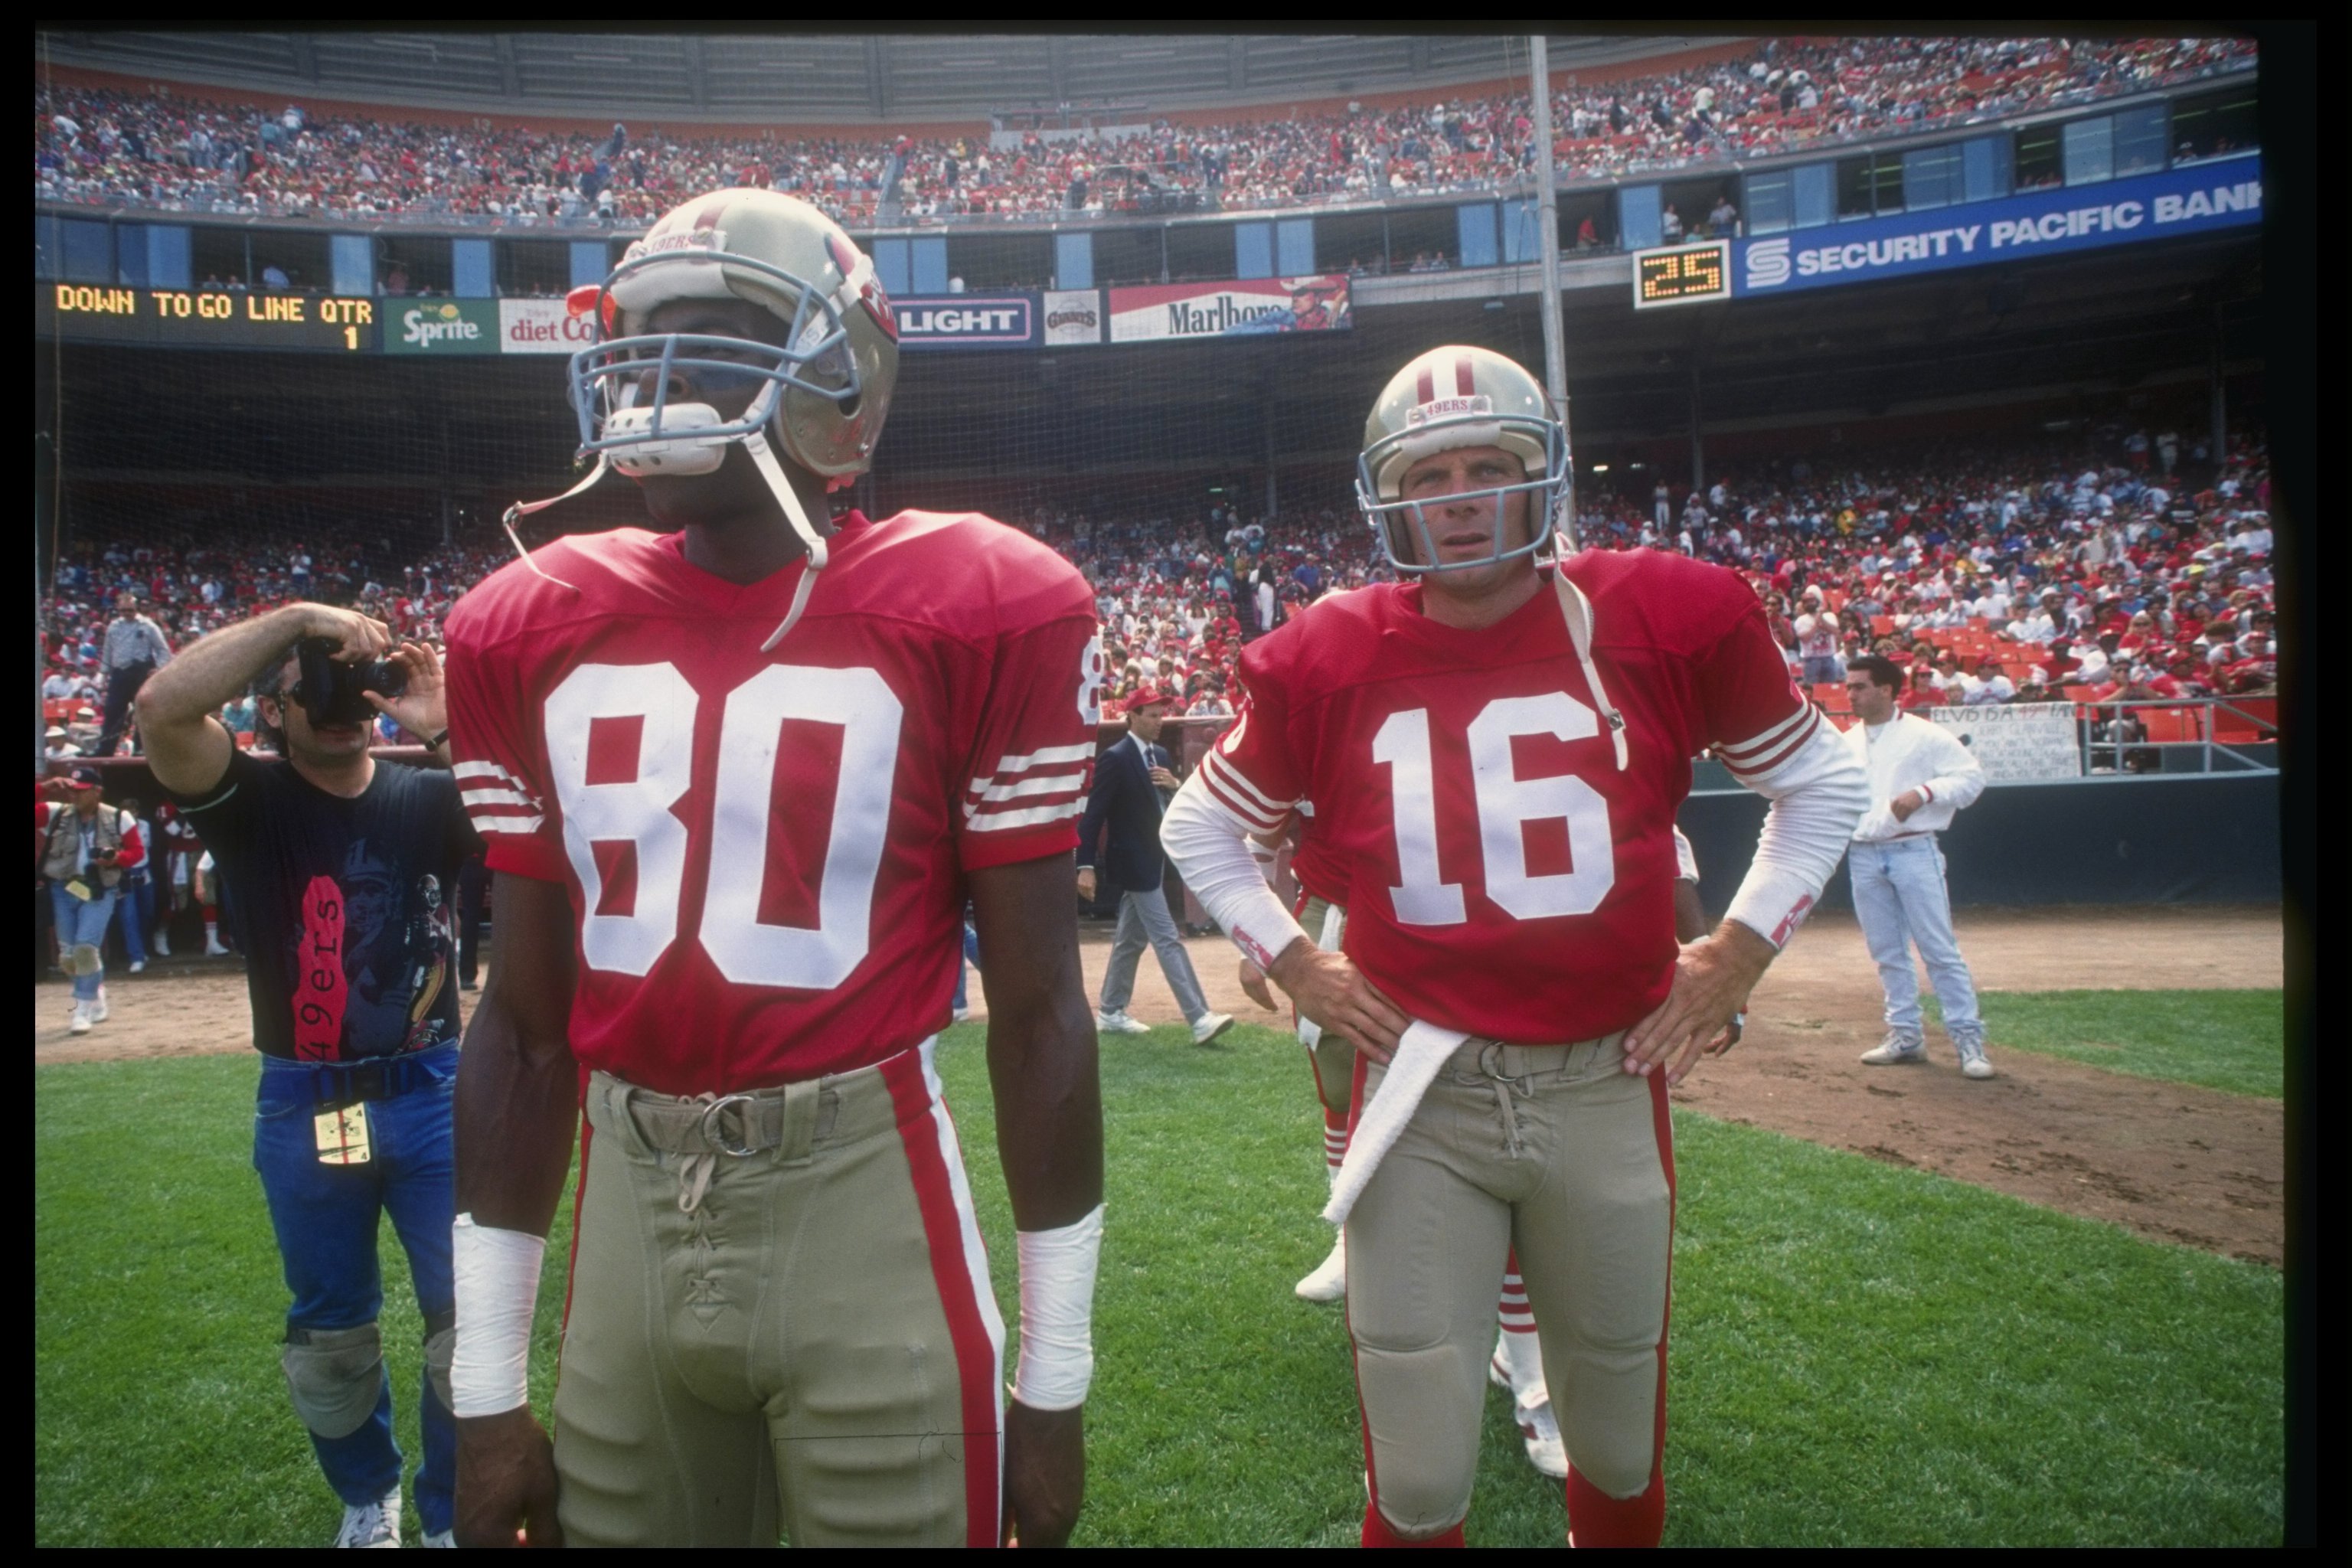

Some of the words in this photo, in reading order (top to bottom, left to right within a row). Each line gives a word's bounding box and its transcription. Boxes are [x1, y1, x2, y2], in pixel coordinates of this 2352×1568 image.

[1797, 225, 1981, 276] SECURITY
[1991, 201, 2143, 248] PACIFIC
[1643, 250, 1719, 298] 25
[57, 285, 134, 314] DOWN
[152, 292, 191, 318] TO
[198, 294, 231, 318] GO
[248, 296, 304, 321] LINE
[321, 299, 372, 324] QTR
[900, 310, 1018, 332] LIGHT
[345, 326, 357, 350] 1
[403, 309, 479, 347] Sprite
[511, 319, 558, 341] diet
[563, 315, 594, 341] Co
[1426, 399, 1468, 416] 49ERS
[544, 661, 903, 989] 80
[1372, 691, 1615, 926] 16
[299, 900, 338, 1060] 49ers
